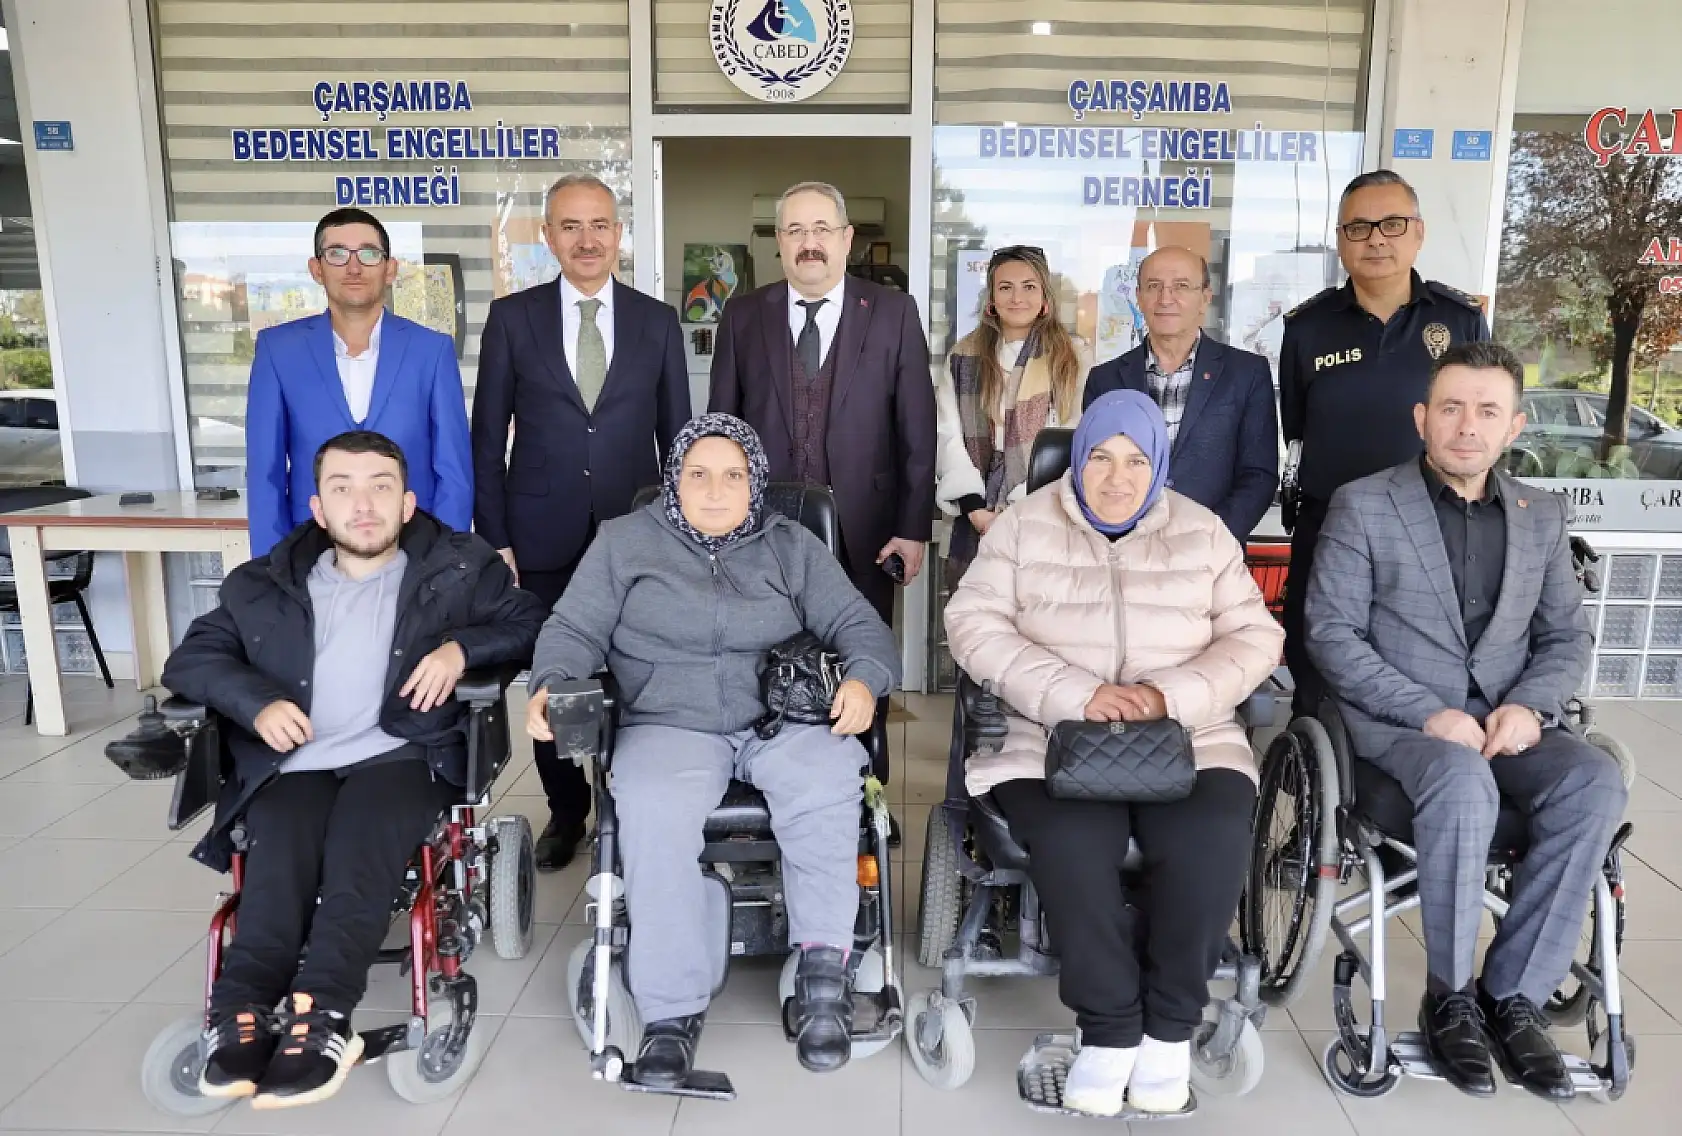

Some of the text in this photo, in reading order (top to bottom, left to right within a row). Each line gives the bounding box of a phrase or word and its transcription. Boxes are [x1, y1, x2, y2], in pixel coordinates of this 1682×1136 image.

[753, 44, 809, 61] ÇABED
[314, 81, 472, 121] ÇARŞAMBA
[766, 89, 796, 99] 2008
[1068, 80, 1232, 120] ÇARŞAMBA
[232, 120, 560, 160] BEDENSEL ENGELLİLER
[979, 121, 1317, 161] BEDENSEL ENGELLİLER
[335, 166, 460, 206] DERNEĞİ
[1083, 167, 1211, 207] DERNEĞİ
